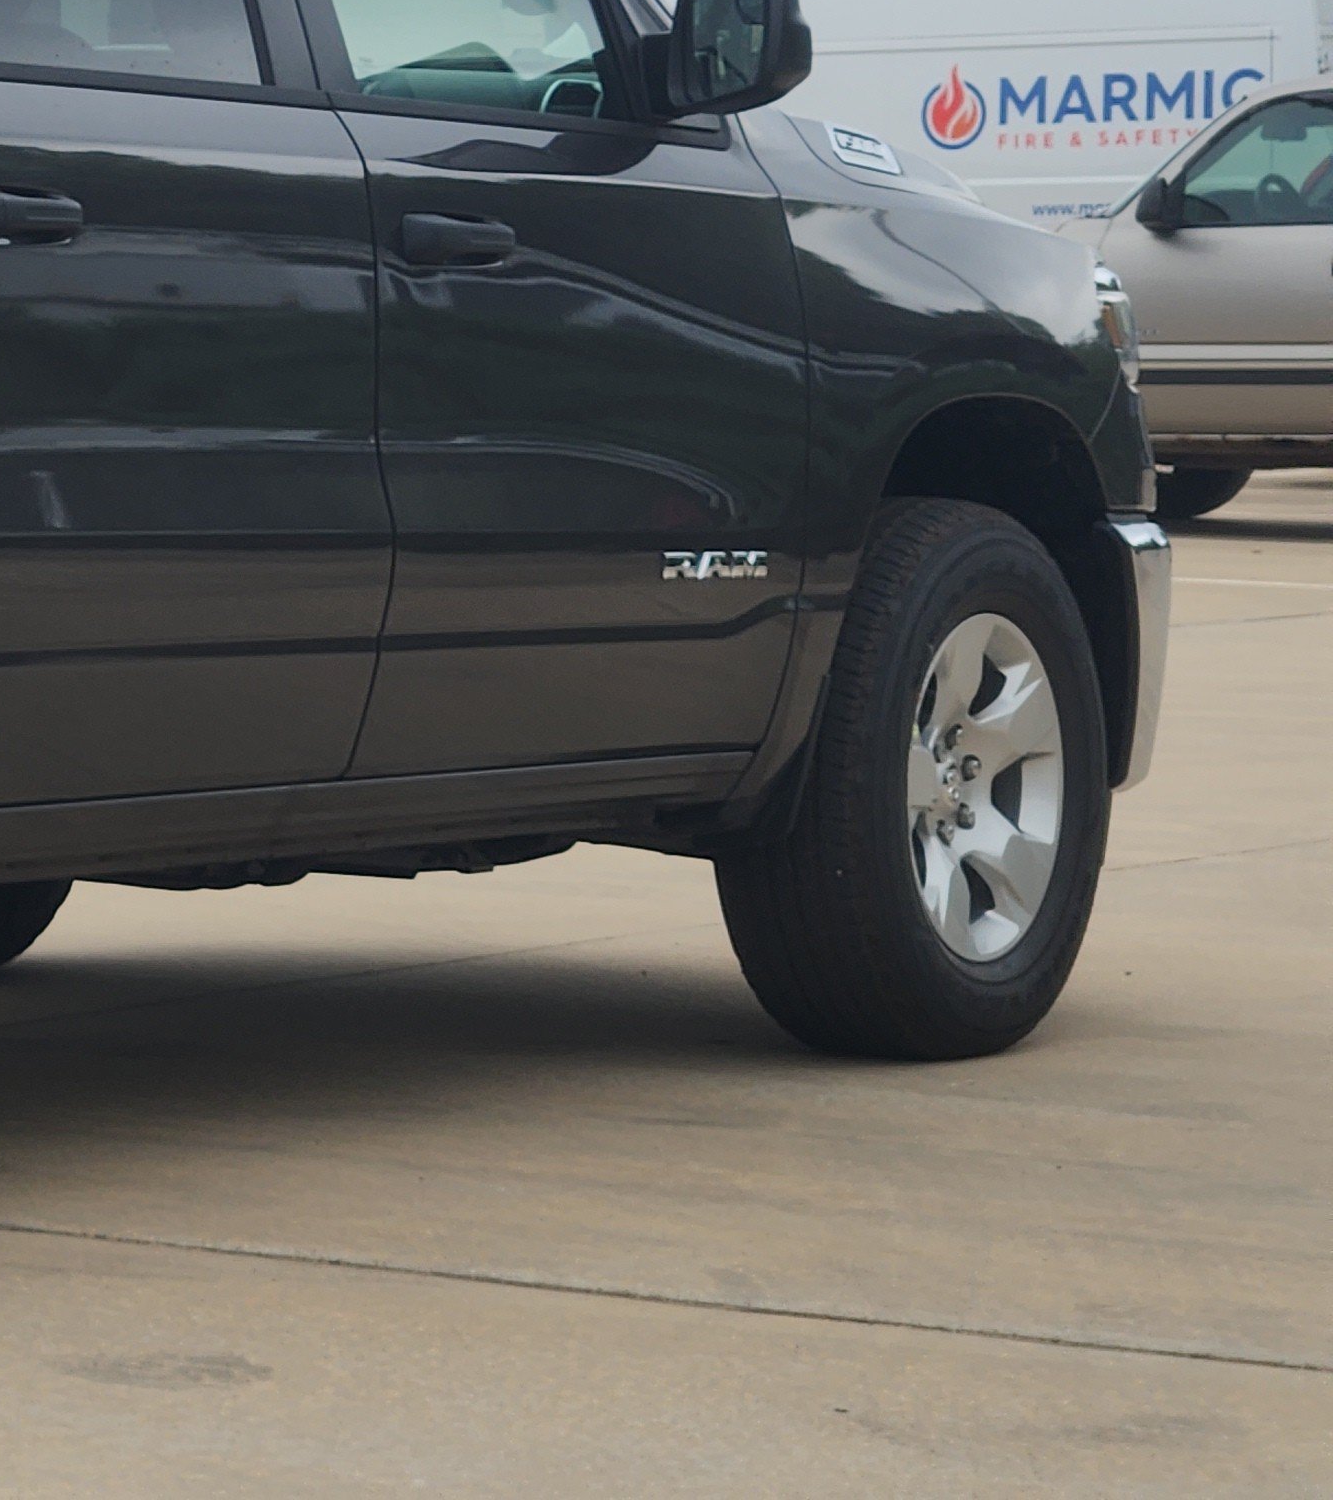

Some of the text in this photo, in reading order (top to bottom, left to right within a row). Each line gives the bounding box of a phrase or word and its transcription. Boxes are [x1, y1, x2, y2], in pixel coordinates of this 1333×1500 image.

[998, 67, 1267, 126] MARMIC
[997, 131, 1055, 150] FIRE
[1069, 130, 1082, 147] &
[662, 550, 769, 580] RAM
